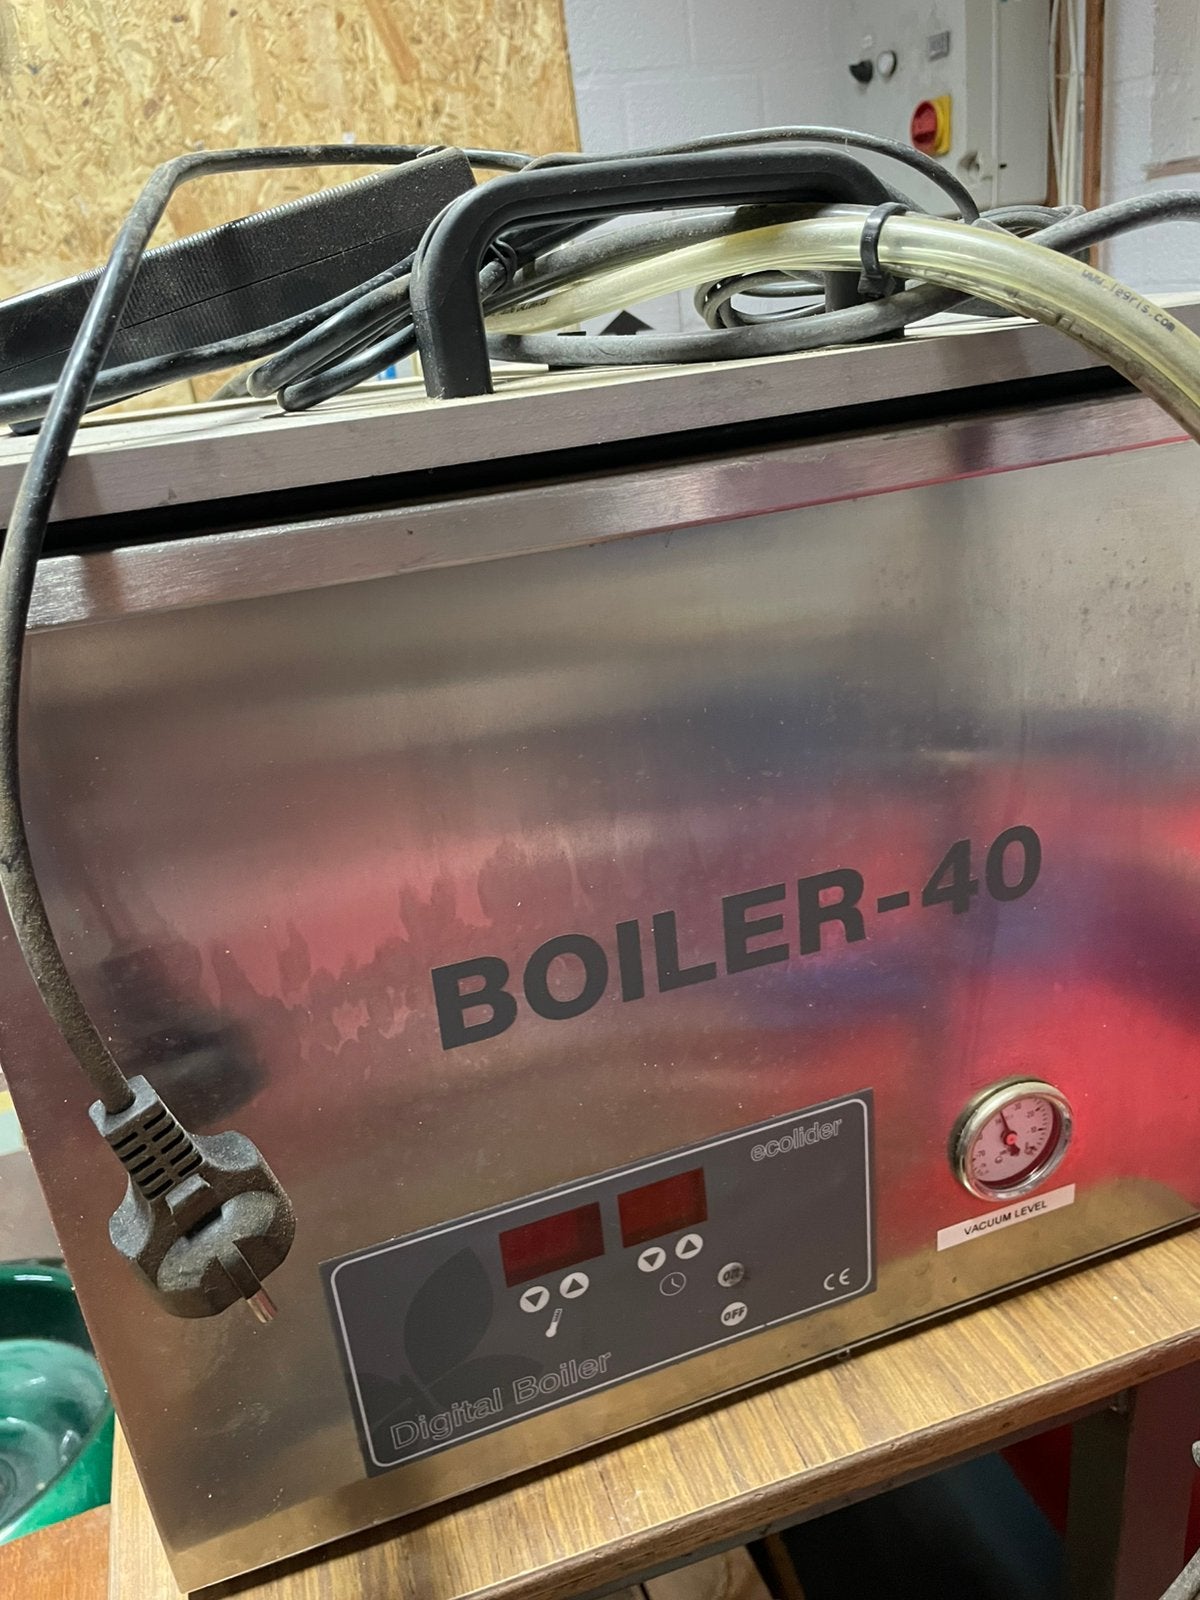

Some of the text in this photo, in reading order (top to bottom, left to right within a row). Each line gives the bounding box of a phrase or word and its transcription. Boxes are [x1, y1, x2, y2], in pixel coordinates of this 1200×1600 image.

[430, 824, 1043, 1051] BOILER-40
[750, 1118, 843, 1162] ecolider
[964, 1199, 1048, 1236] VACUUM LEVEL
[723, 1306, 746, 1322] OFF
[390, 1351, 612, 1450] Digital Boiler
